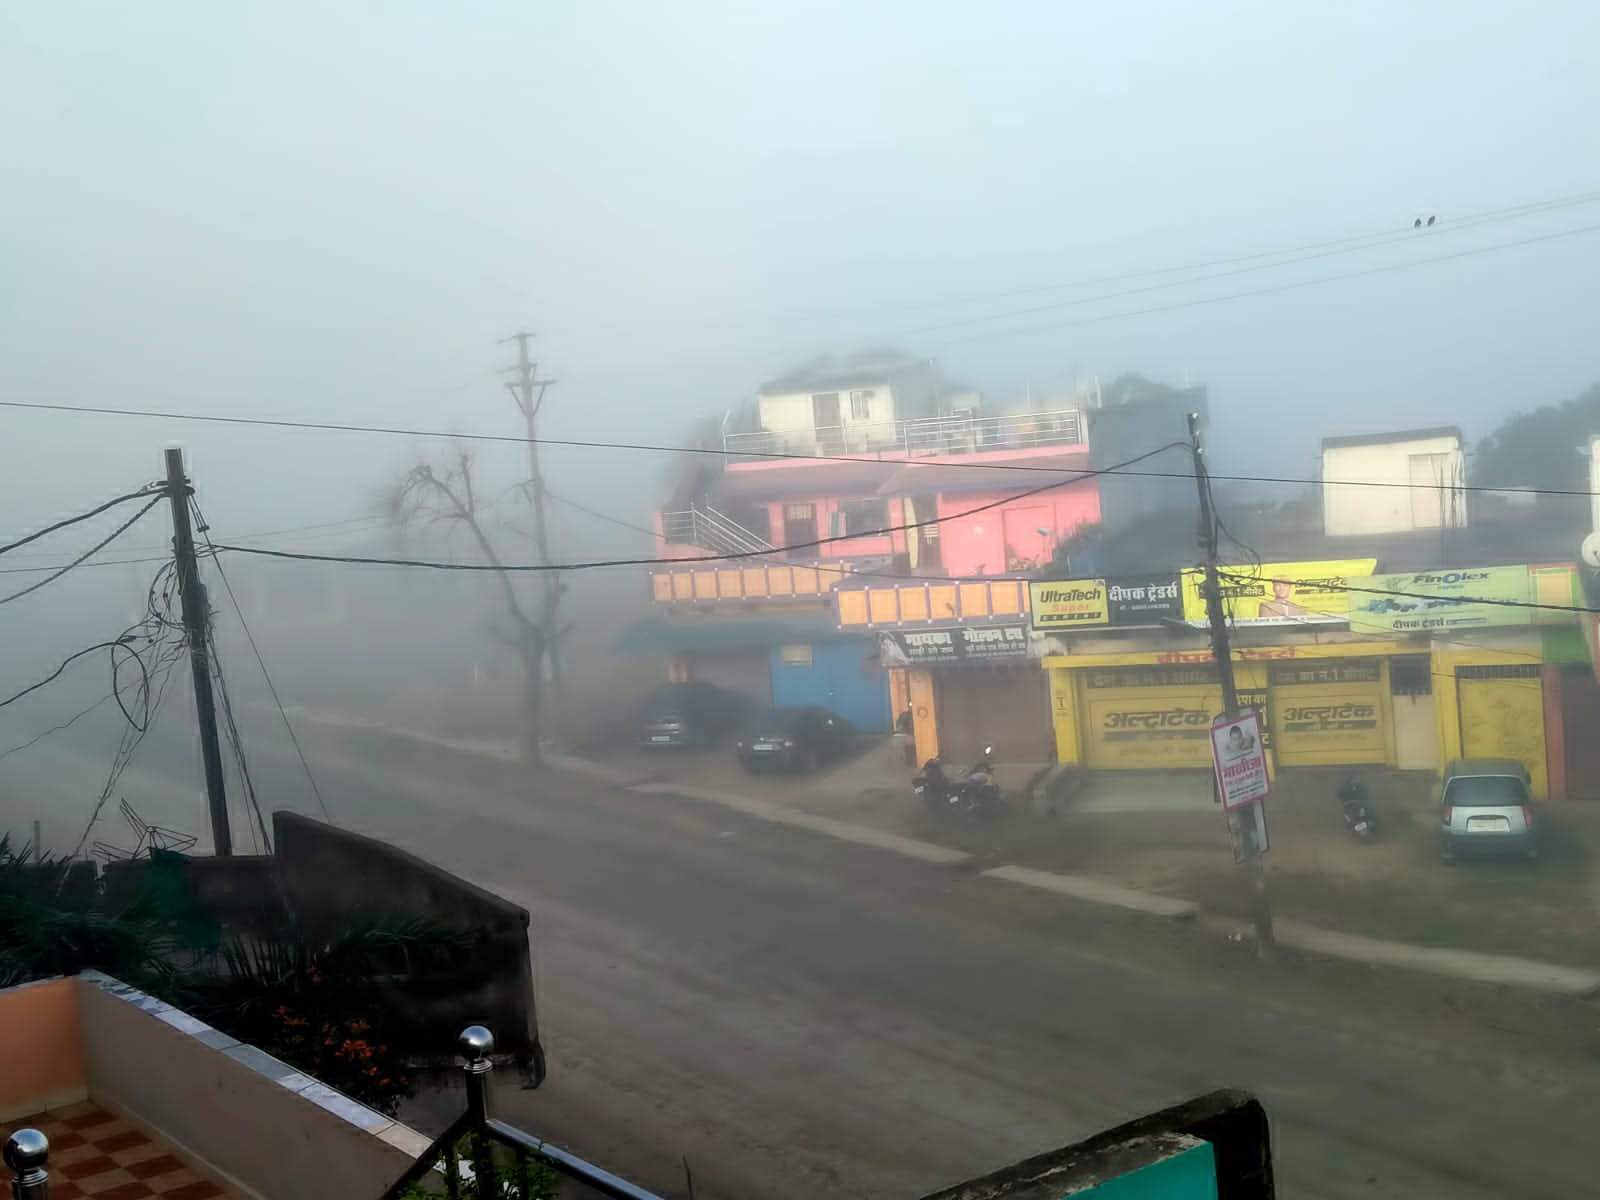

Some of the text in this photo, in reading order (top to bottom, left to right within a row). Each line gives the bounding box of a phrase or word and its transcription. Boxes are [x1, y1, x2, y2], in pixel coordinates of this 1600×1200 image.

[1040, 588, 1101, 603] UltraTech
[1109, 581, 1177, 602] दीपक ट्रेडर्स
[1104, 707, 1210, 729] अल्ट्राटेक
[1283, 702, 1377, 721] अल्ट्राटेक
